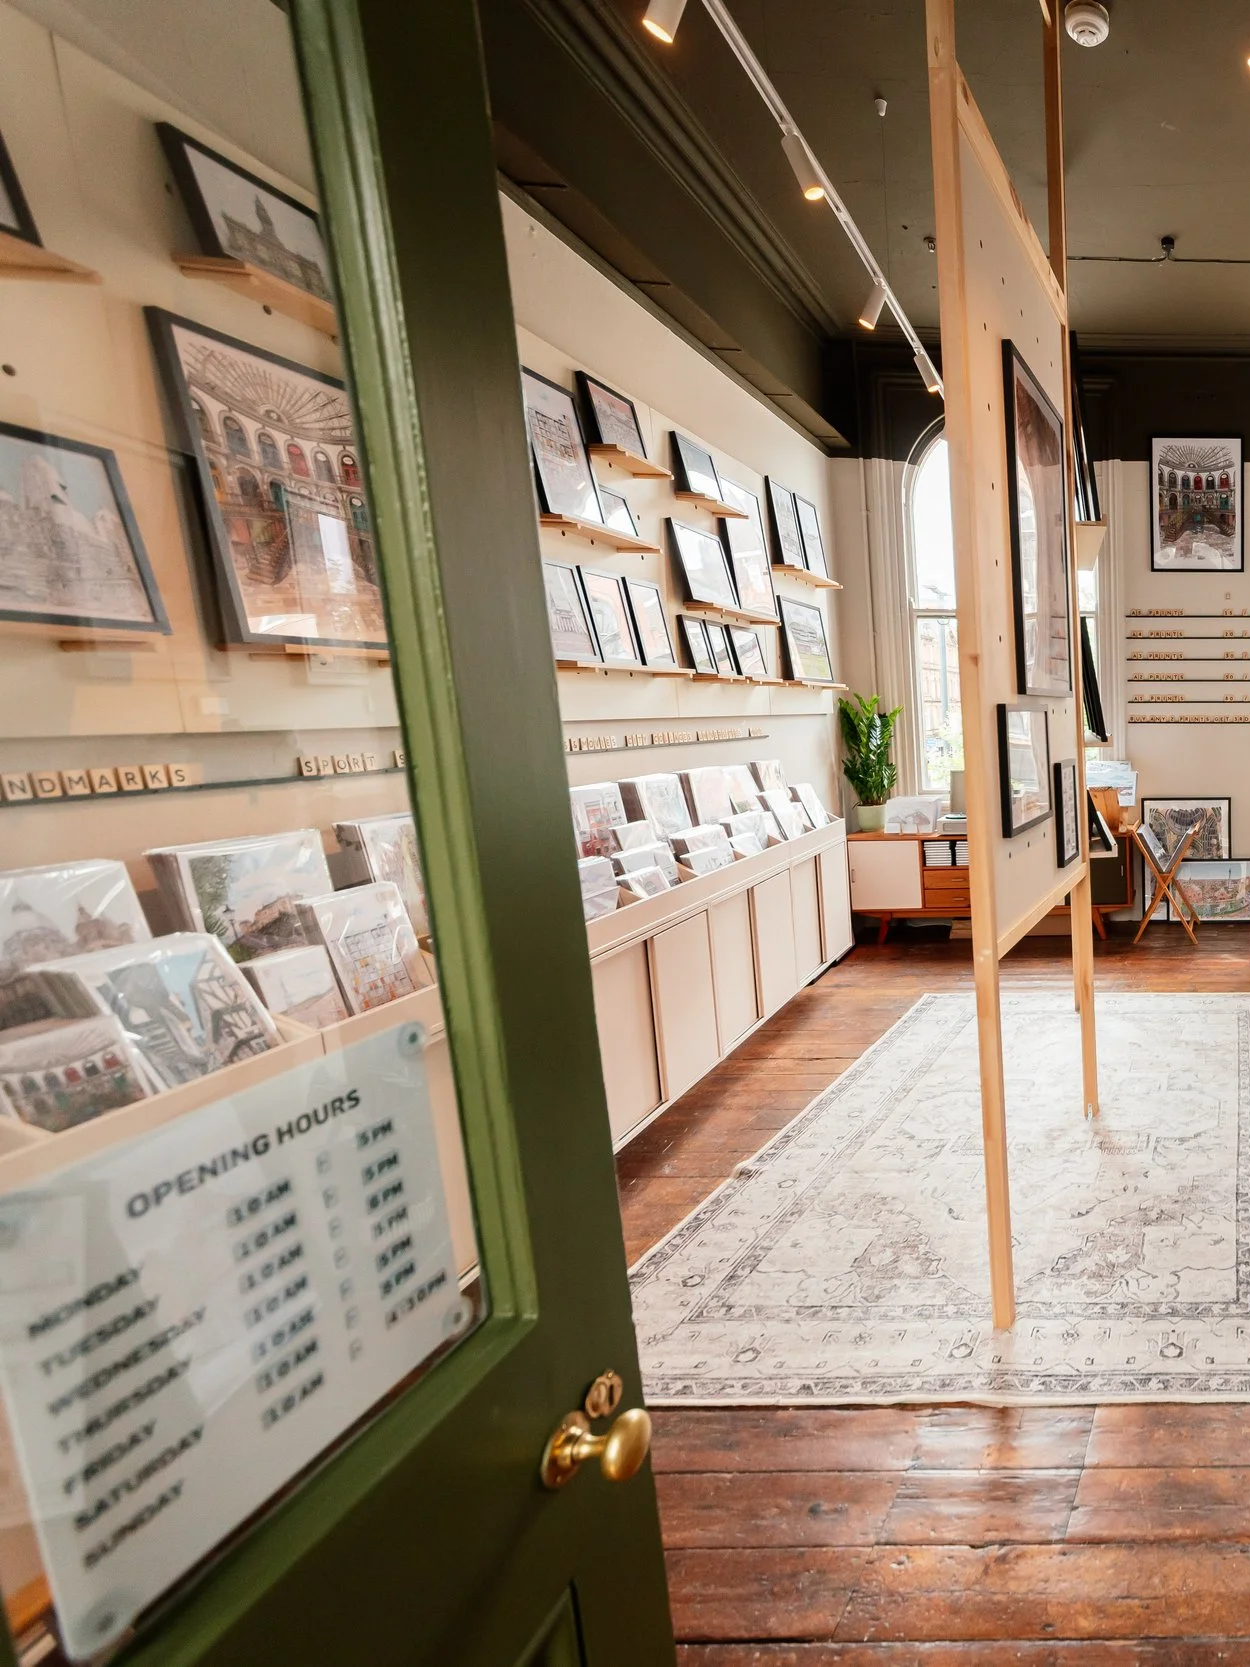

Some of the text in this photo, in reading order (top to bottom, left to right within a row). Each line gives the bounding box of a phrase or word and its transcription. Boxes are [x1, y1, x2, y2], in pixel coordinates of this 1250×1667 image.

[304, 756, 375, 773] SPORT
[581, 737, 617, 749] MOVIES
[125, 1087, 361, 1219] OPENING HOURS
[28, 1262, 144, 1340] MONDAY
[41, 1294, 161, 1376] TUESDAY
[48, 1305, 207, 1416] WEDNESDAY
[57, 1356, 192, 1454] THURSDAY
[63, 1418, 158, 1496] FRIDAY
[72, 1423, 205, 1532] SATURDAY
[82, 1477, 185, 1569] SUNDAY
